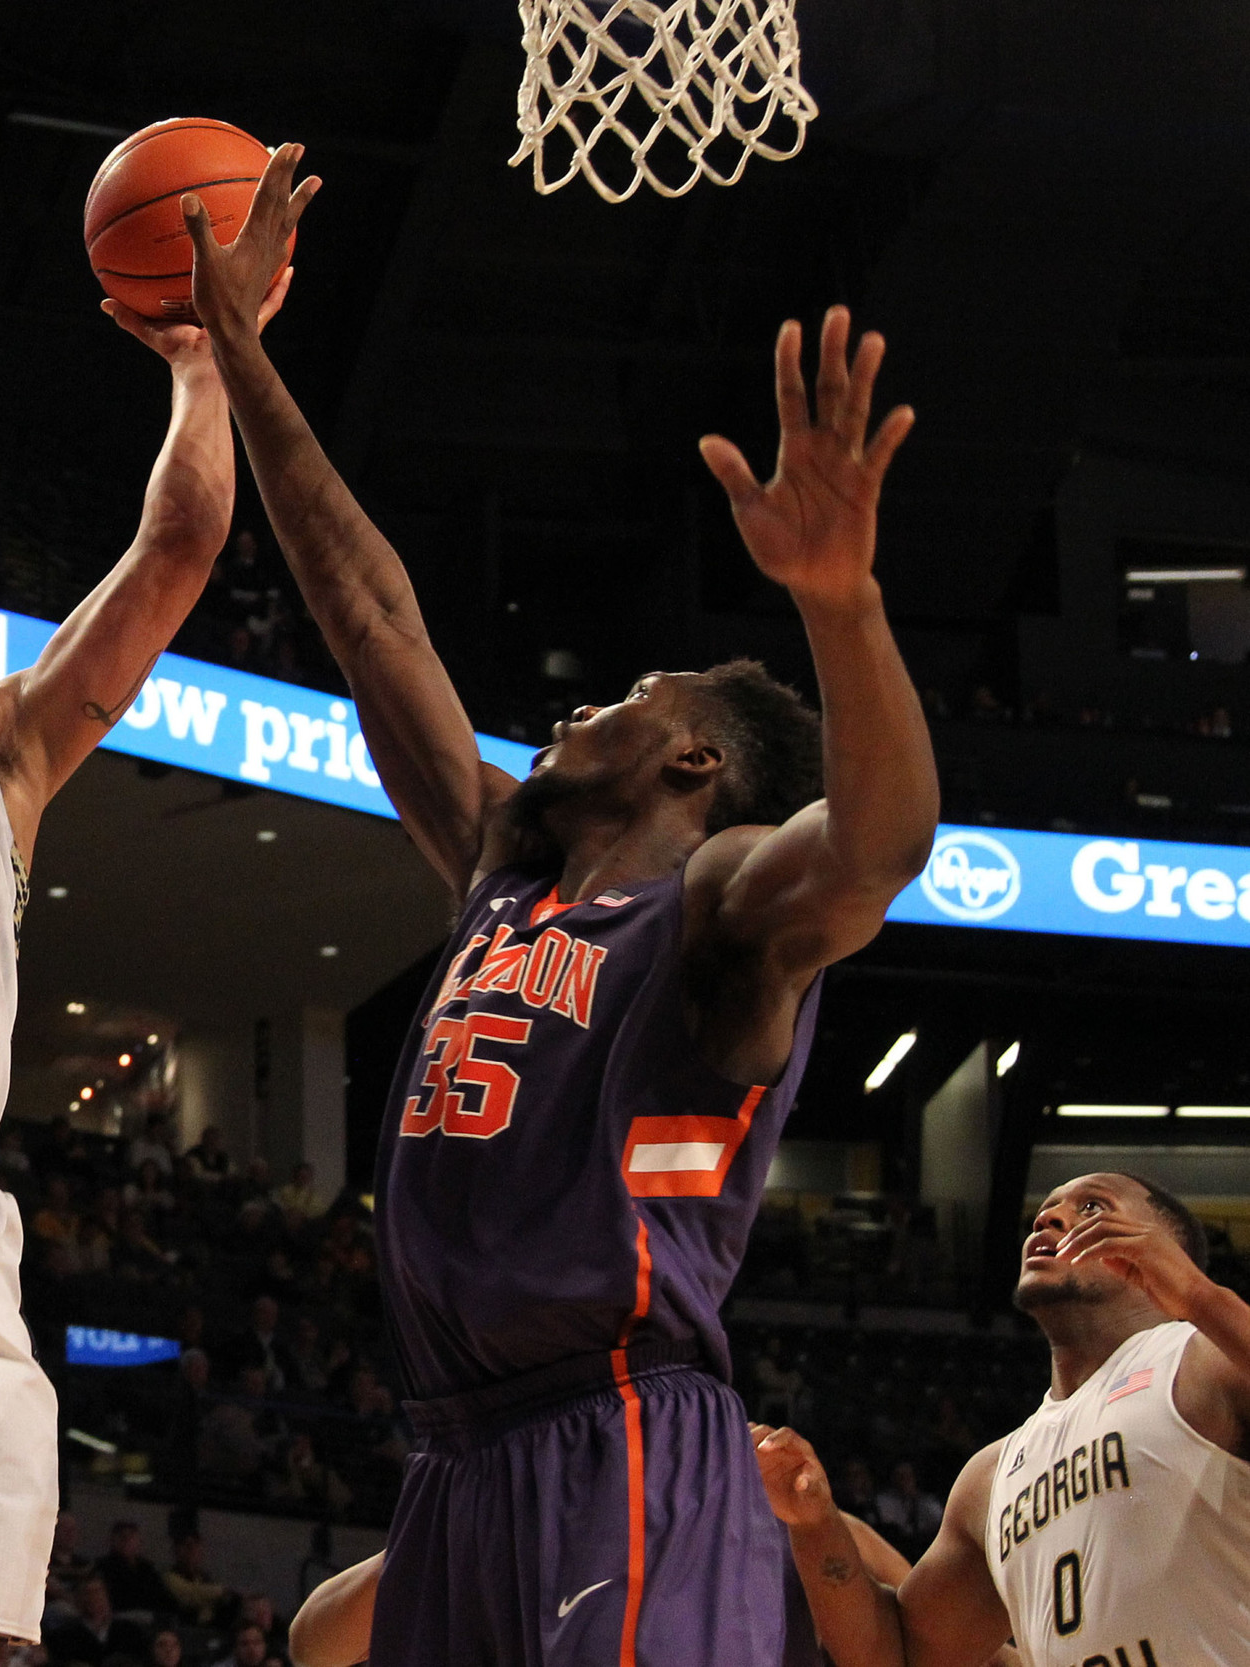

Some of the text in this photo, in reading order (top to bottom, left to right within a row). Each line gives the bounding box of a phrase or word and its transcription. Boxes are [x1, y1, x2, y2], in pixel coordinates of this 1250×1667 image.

[932, 847, 1012, 908] Kroger
[1071, 840, 1250, 924] Gre
[399, 1011, 534, 1140] 35
[1000, 1431, 1132, 1564] GEORGIA
[1053, 1550, 1084, 1639] 0
